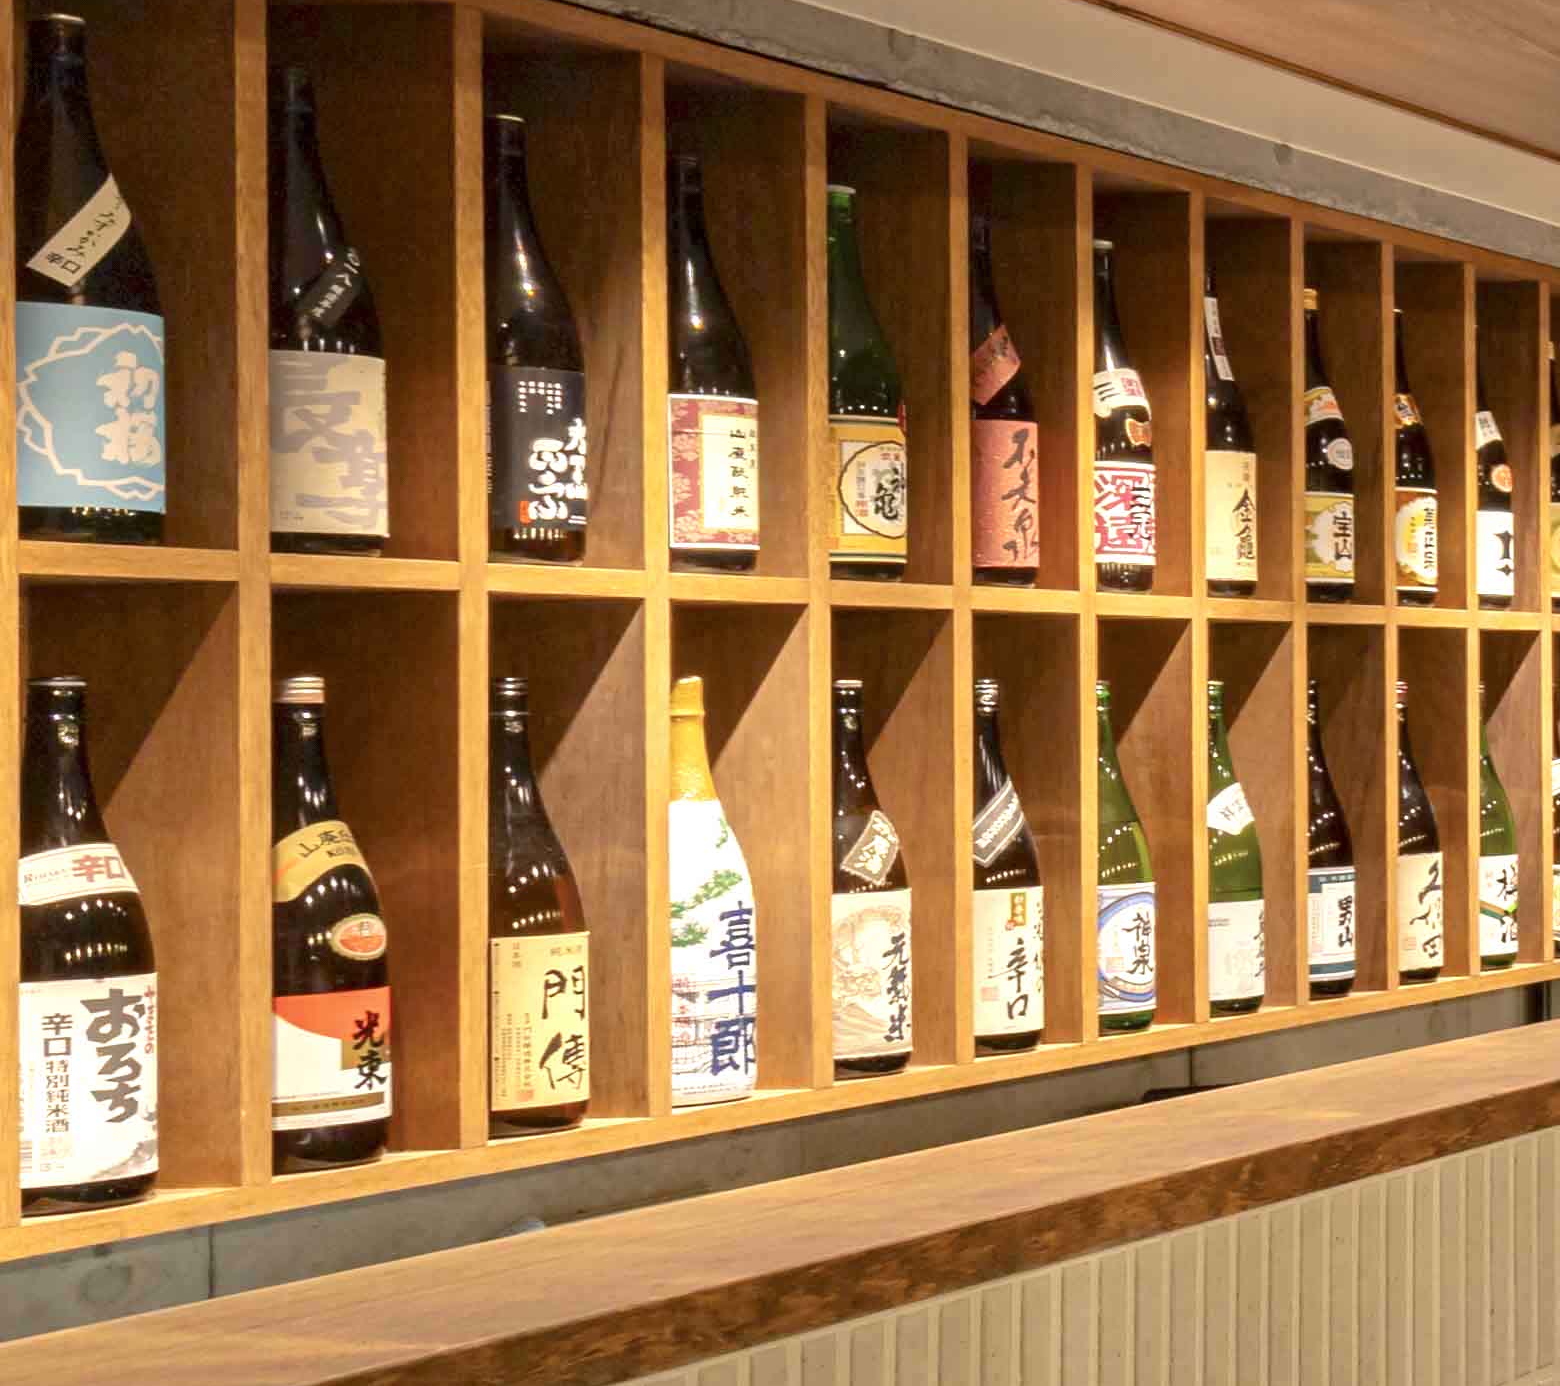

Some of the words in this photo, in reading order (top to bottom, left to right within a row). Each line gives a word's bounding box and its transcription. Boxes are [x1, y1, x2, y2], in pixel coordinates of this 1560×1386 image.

[72, 854, 126, 883] 辛口
[42, 1012, 73, 1058] 辛口
[80, 989, 145, 1123] おろち
